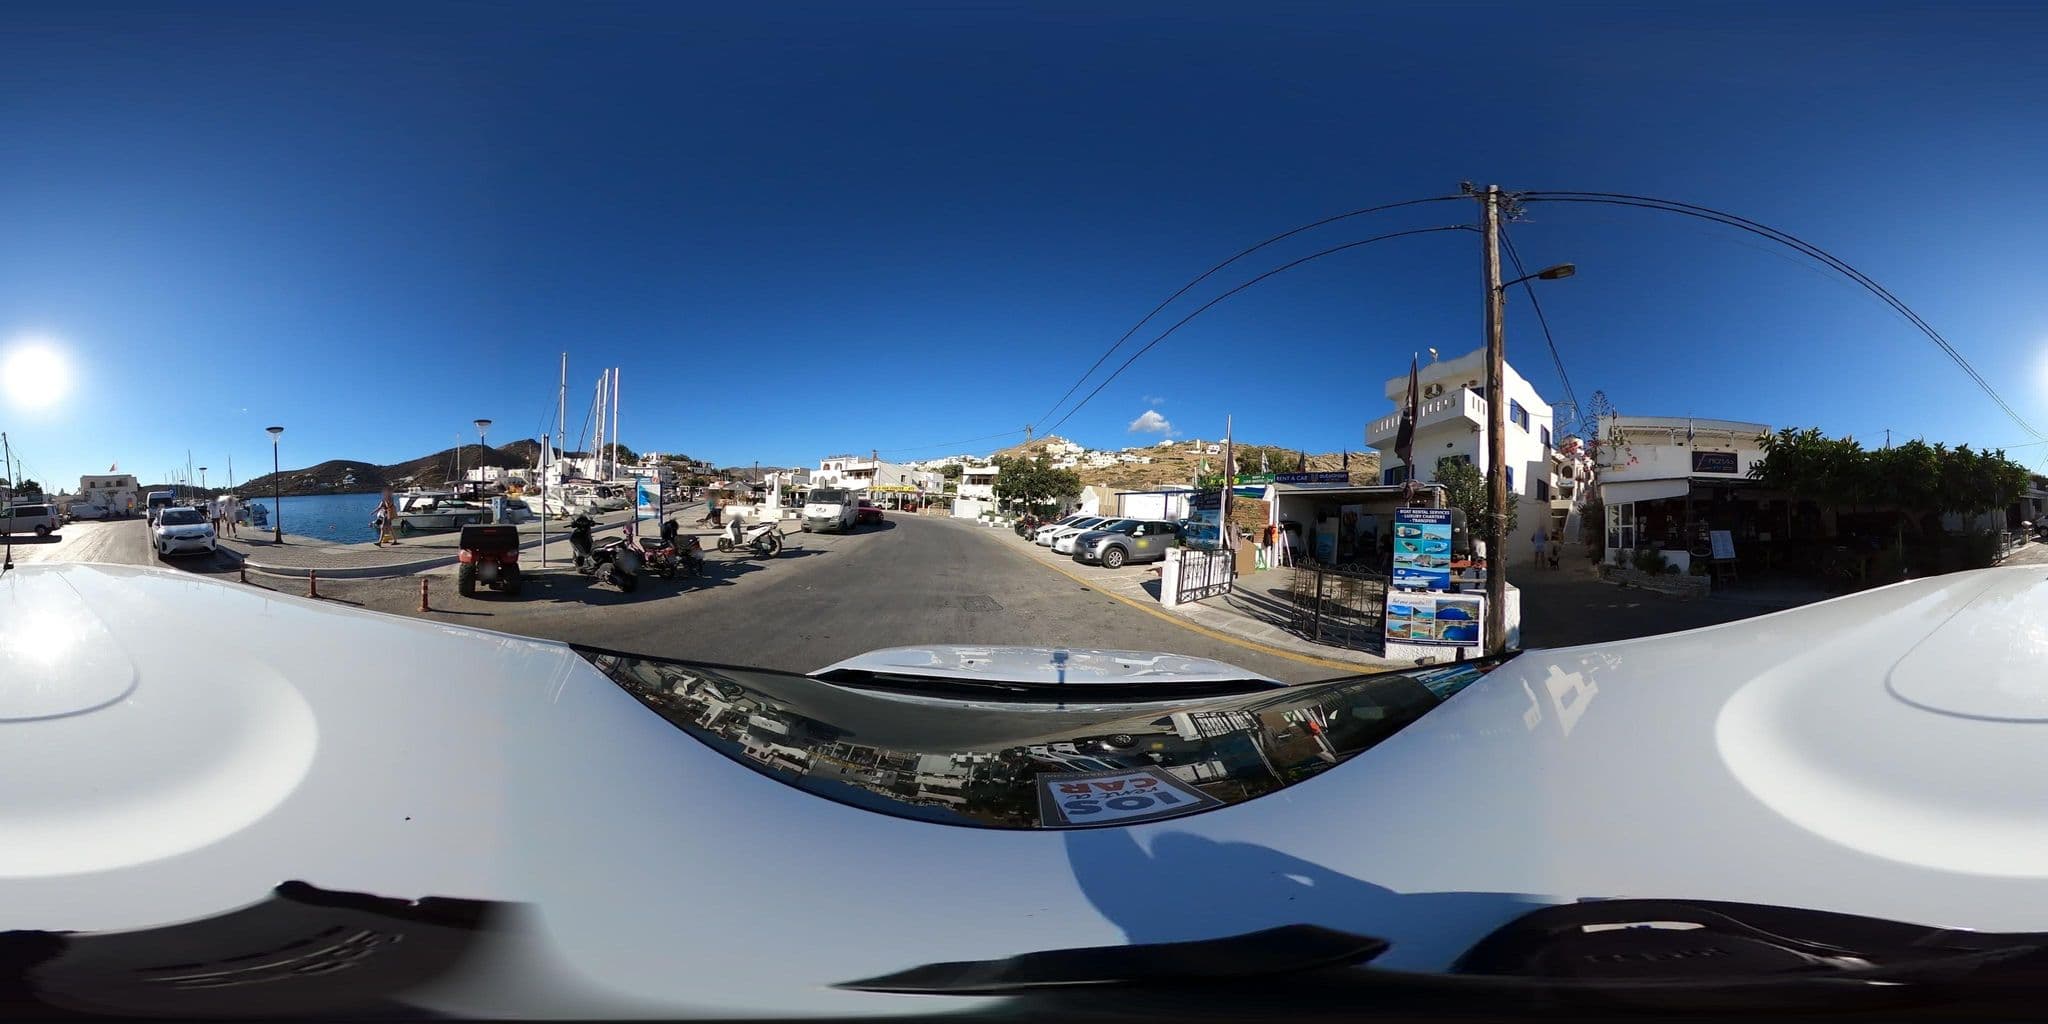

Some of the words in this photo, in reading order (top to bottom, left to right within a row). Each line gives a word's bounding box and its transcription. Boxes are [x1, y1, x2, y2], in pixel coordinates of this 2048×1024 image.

[1060, 778, 1158, 794] CAR
[1097, 787, 1158, 799] rent
[1064, 792, 1182, 814] IOS
